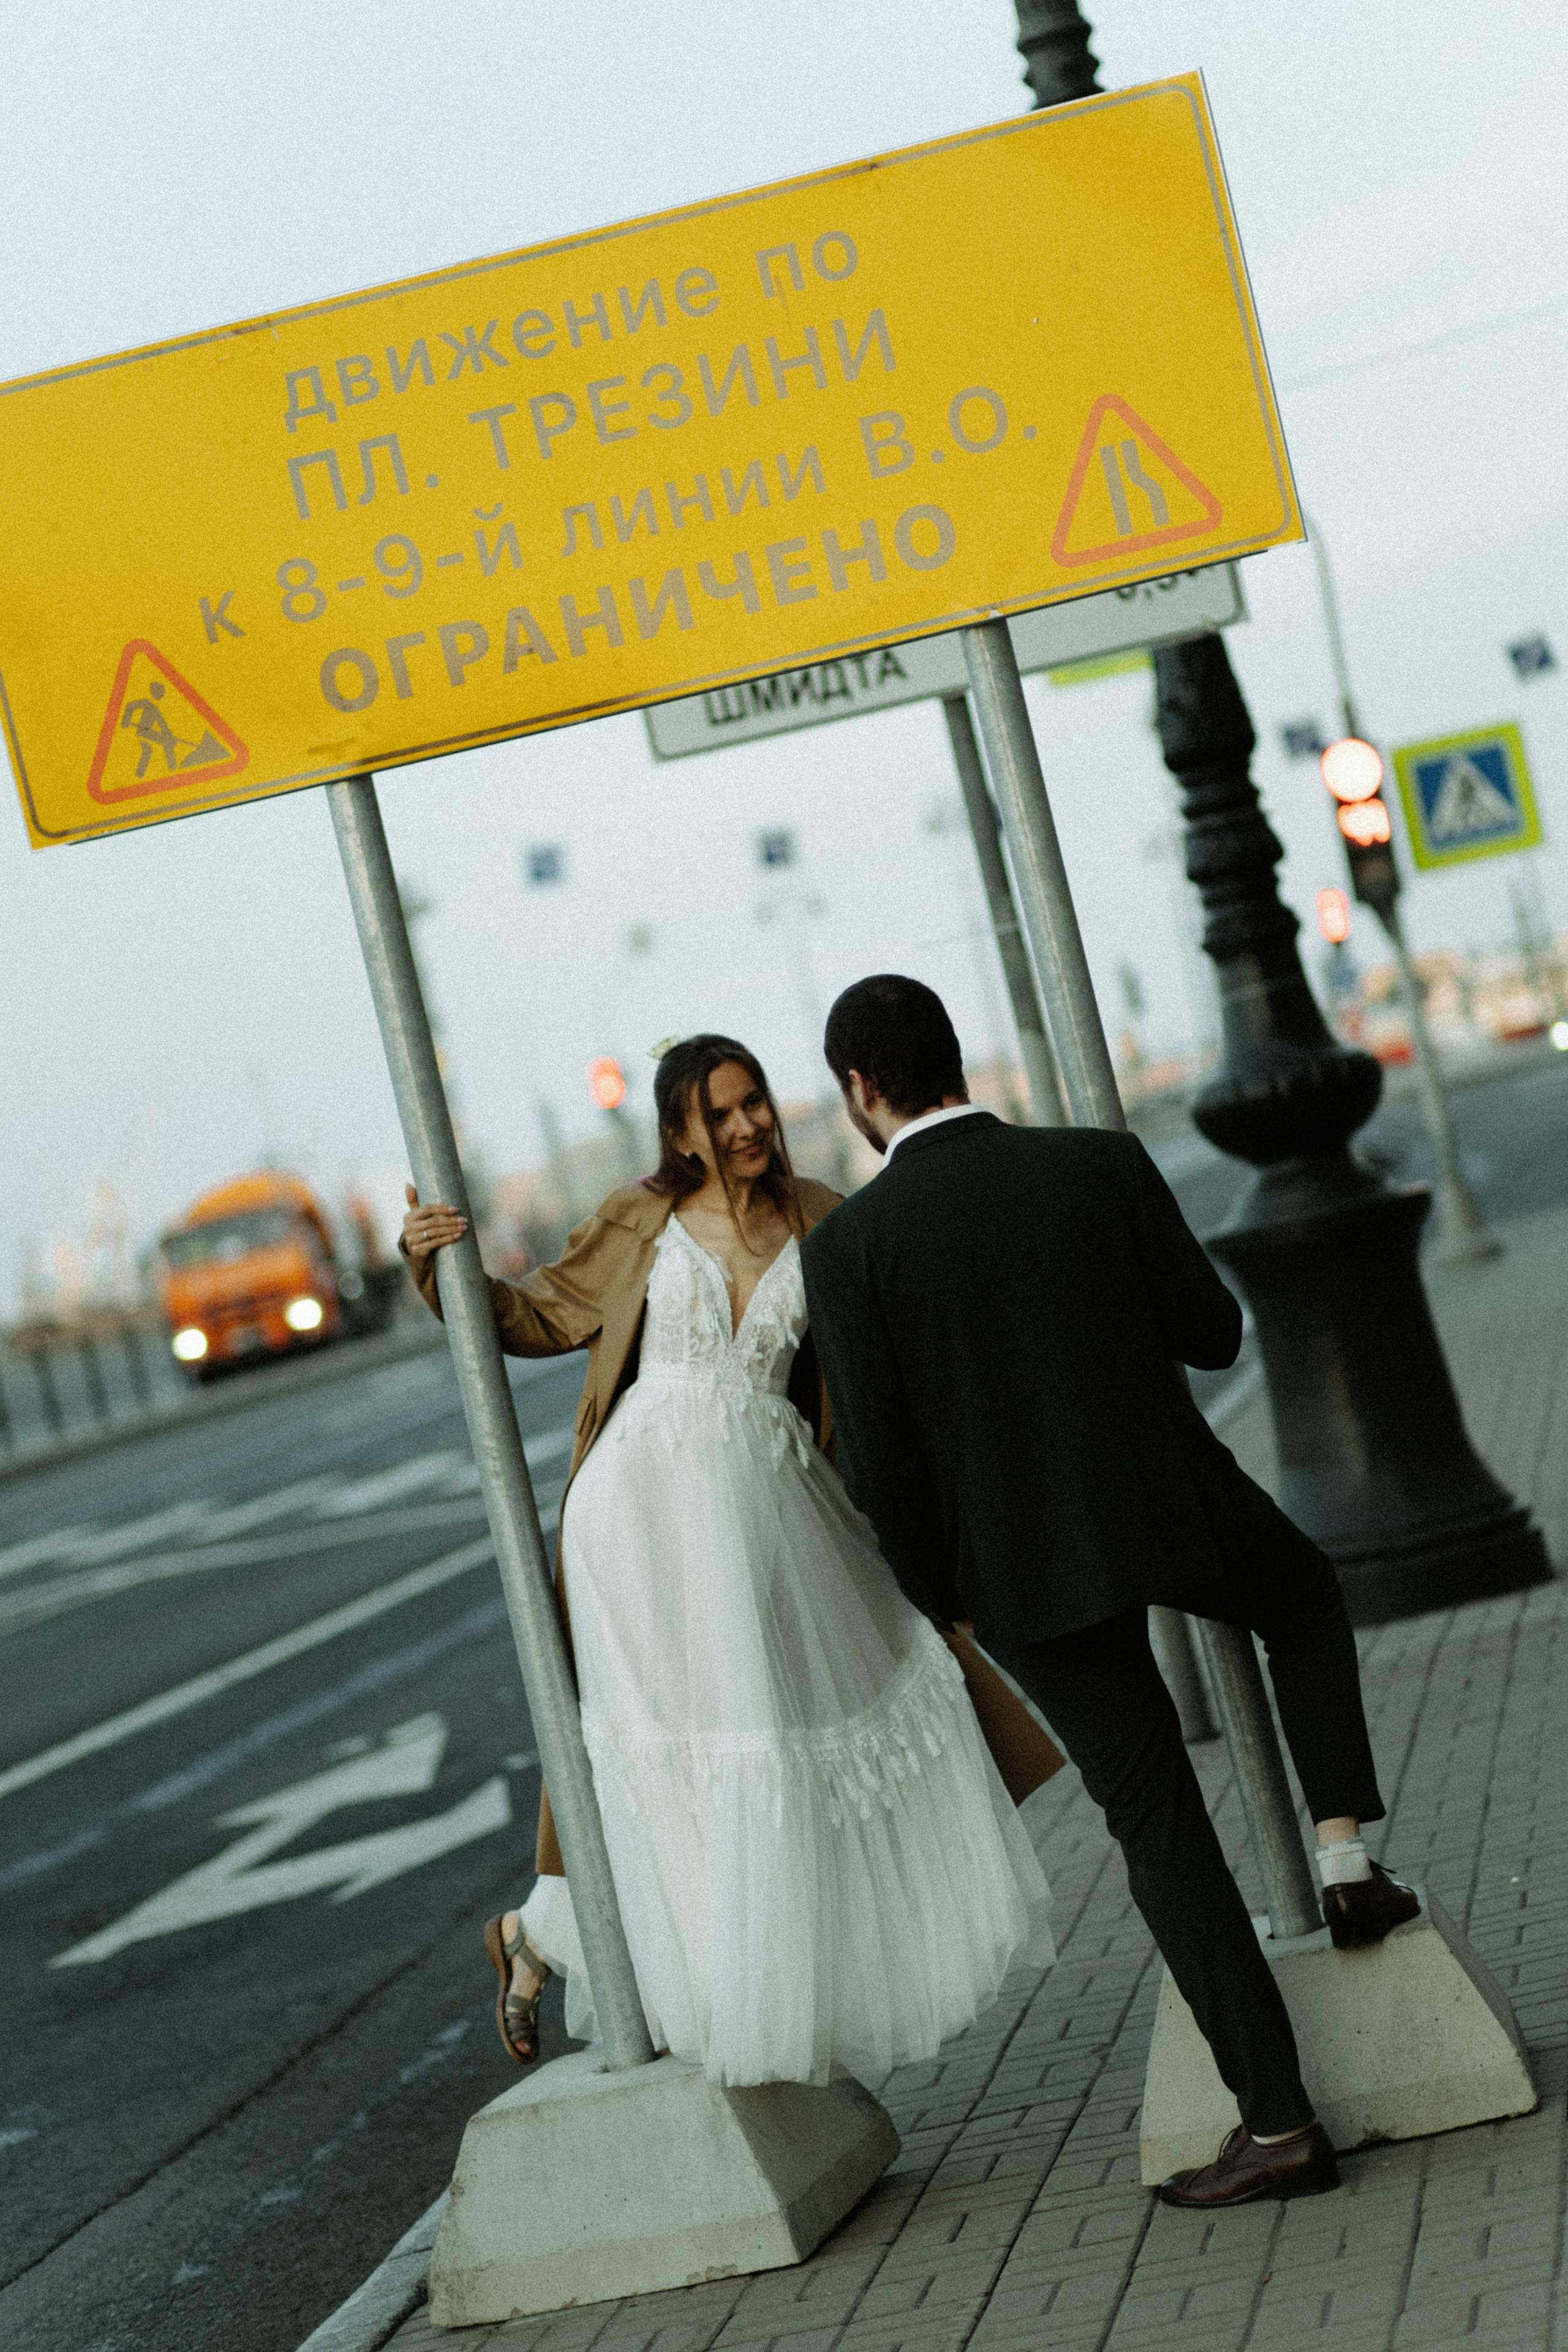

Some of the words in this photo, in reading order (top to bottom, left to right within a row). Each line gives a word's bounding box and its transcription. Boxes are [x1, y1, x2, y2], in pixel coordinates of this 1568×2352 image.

[283, 266, 720, 434] движение
[754, 230, 859, 300] по
[285, 432, 441, 521] ПЛ.
[467, 307, 897, 471] ТРЕЗИНИ
[275, 502, 524, 624] 8-9-й
[560, 445, 827, 558] линии
[858, 385, 1038, 480] В.О.
[319, 503, 957, 714] ОГРАНИЧЕНО
[702, 649, 908, 726] ШМИДТА
